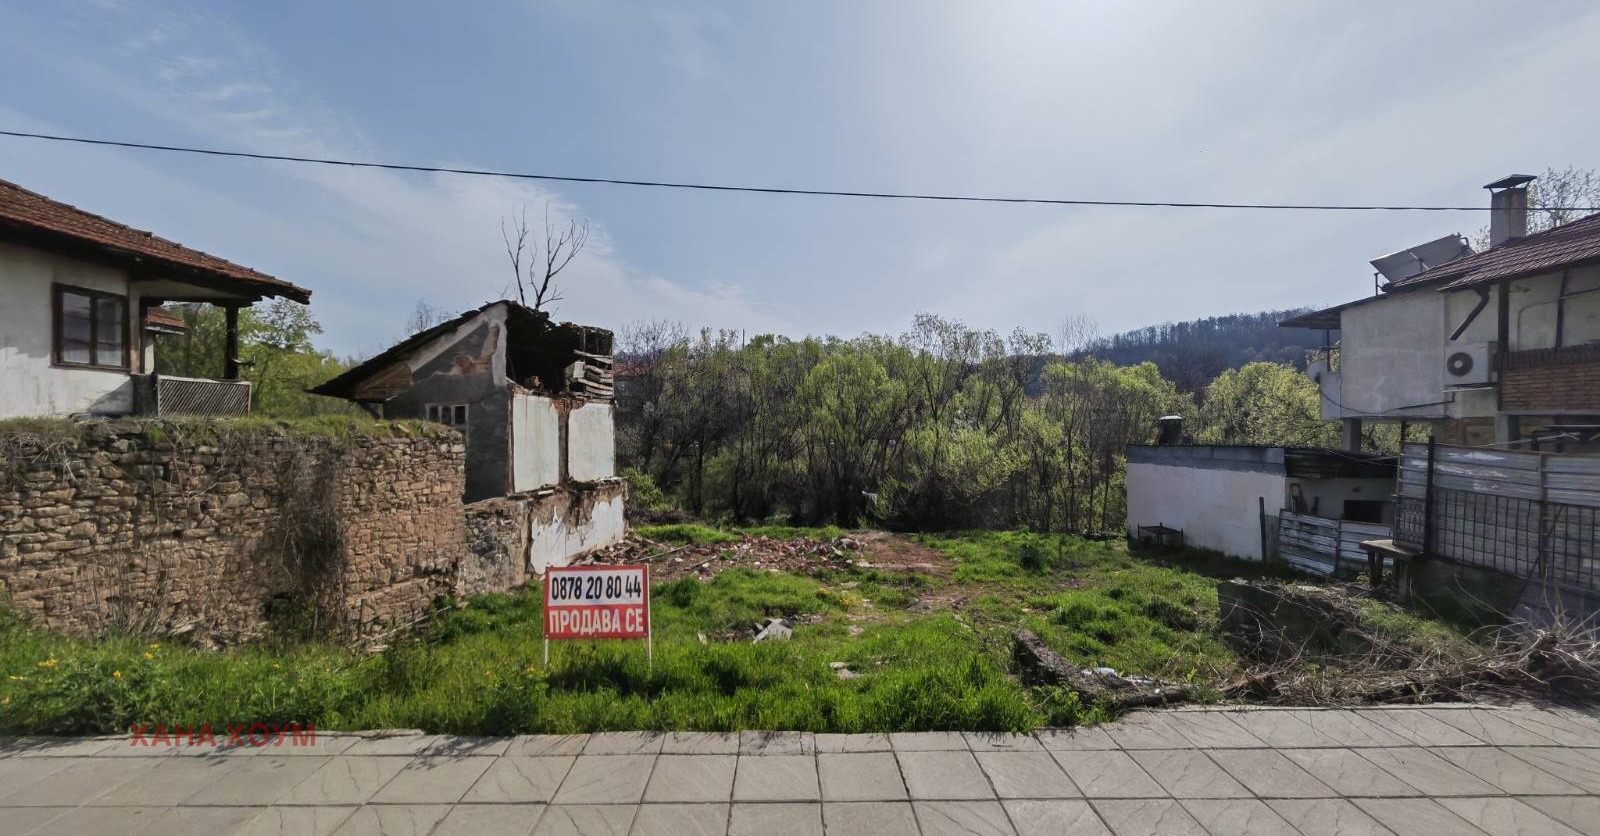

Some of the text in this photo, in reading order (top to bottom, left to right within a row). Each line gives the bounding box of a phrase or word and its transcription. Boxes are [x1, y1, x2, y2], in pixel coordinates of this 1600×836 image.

[552, 575, 641, 600] 0878 20 80 44
[549, 608, 644, 635] ПРОДАВА СЕ
